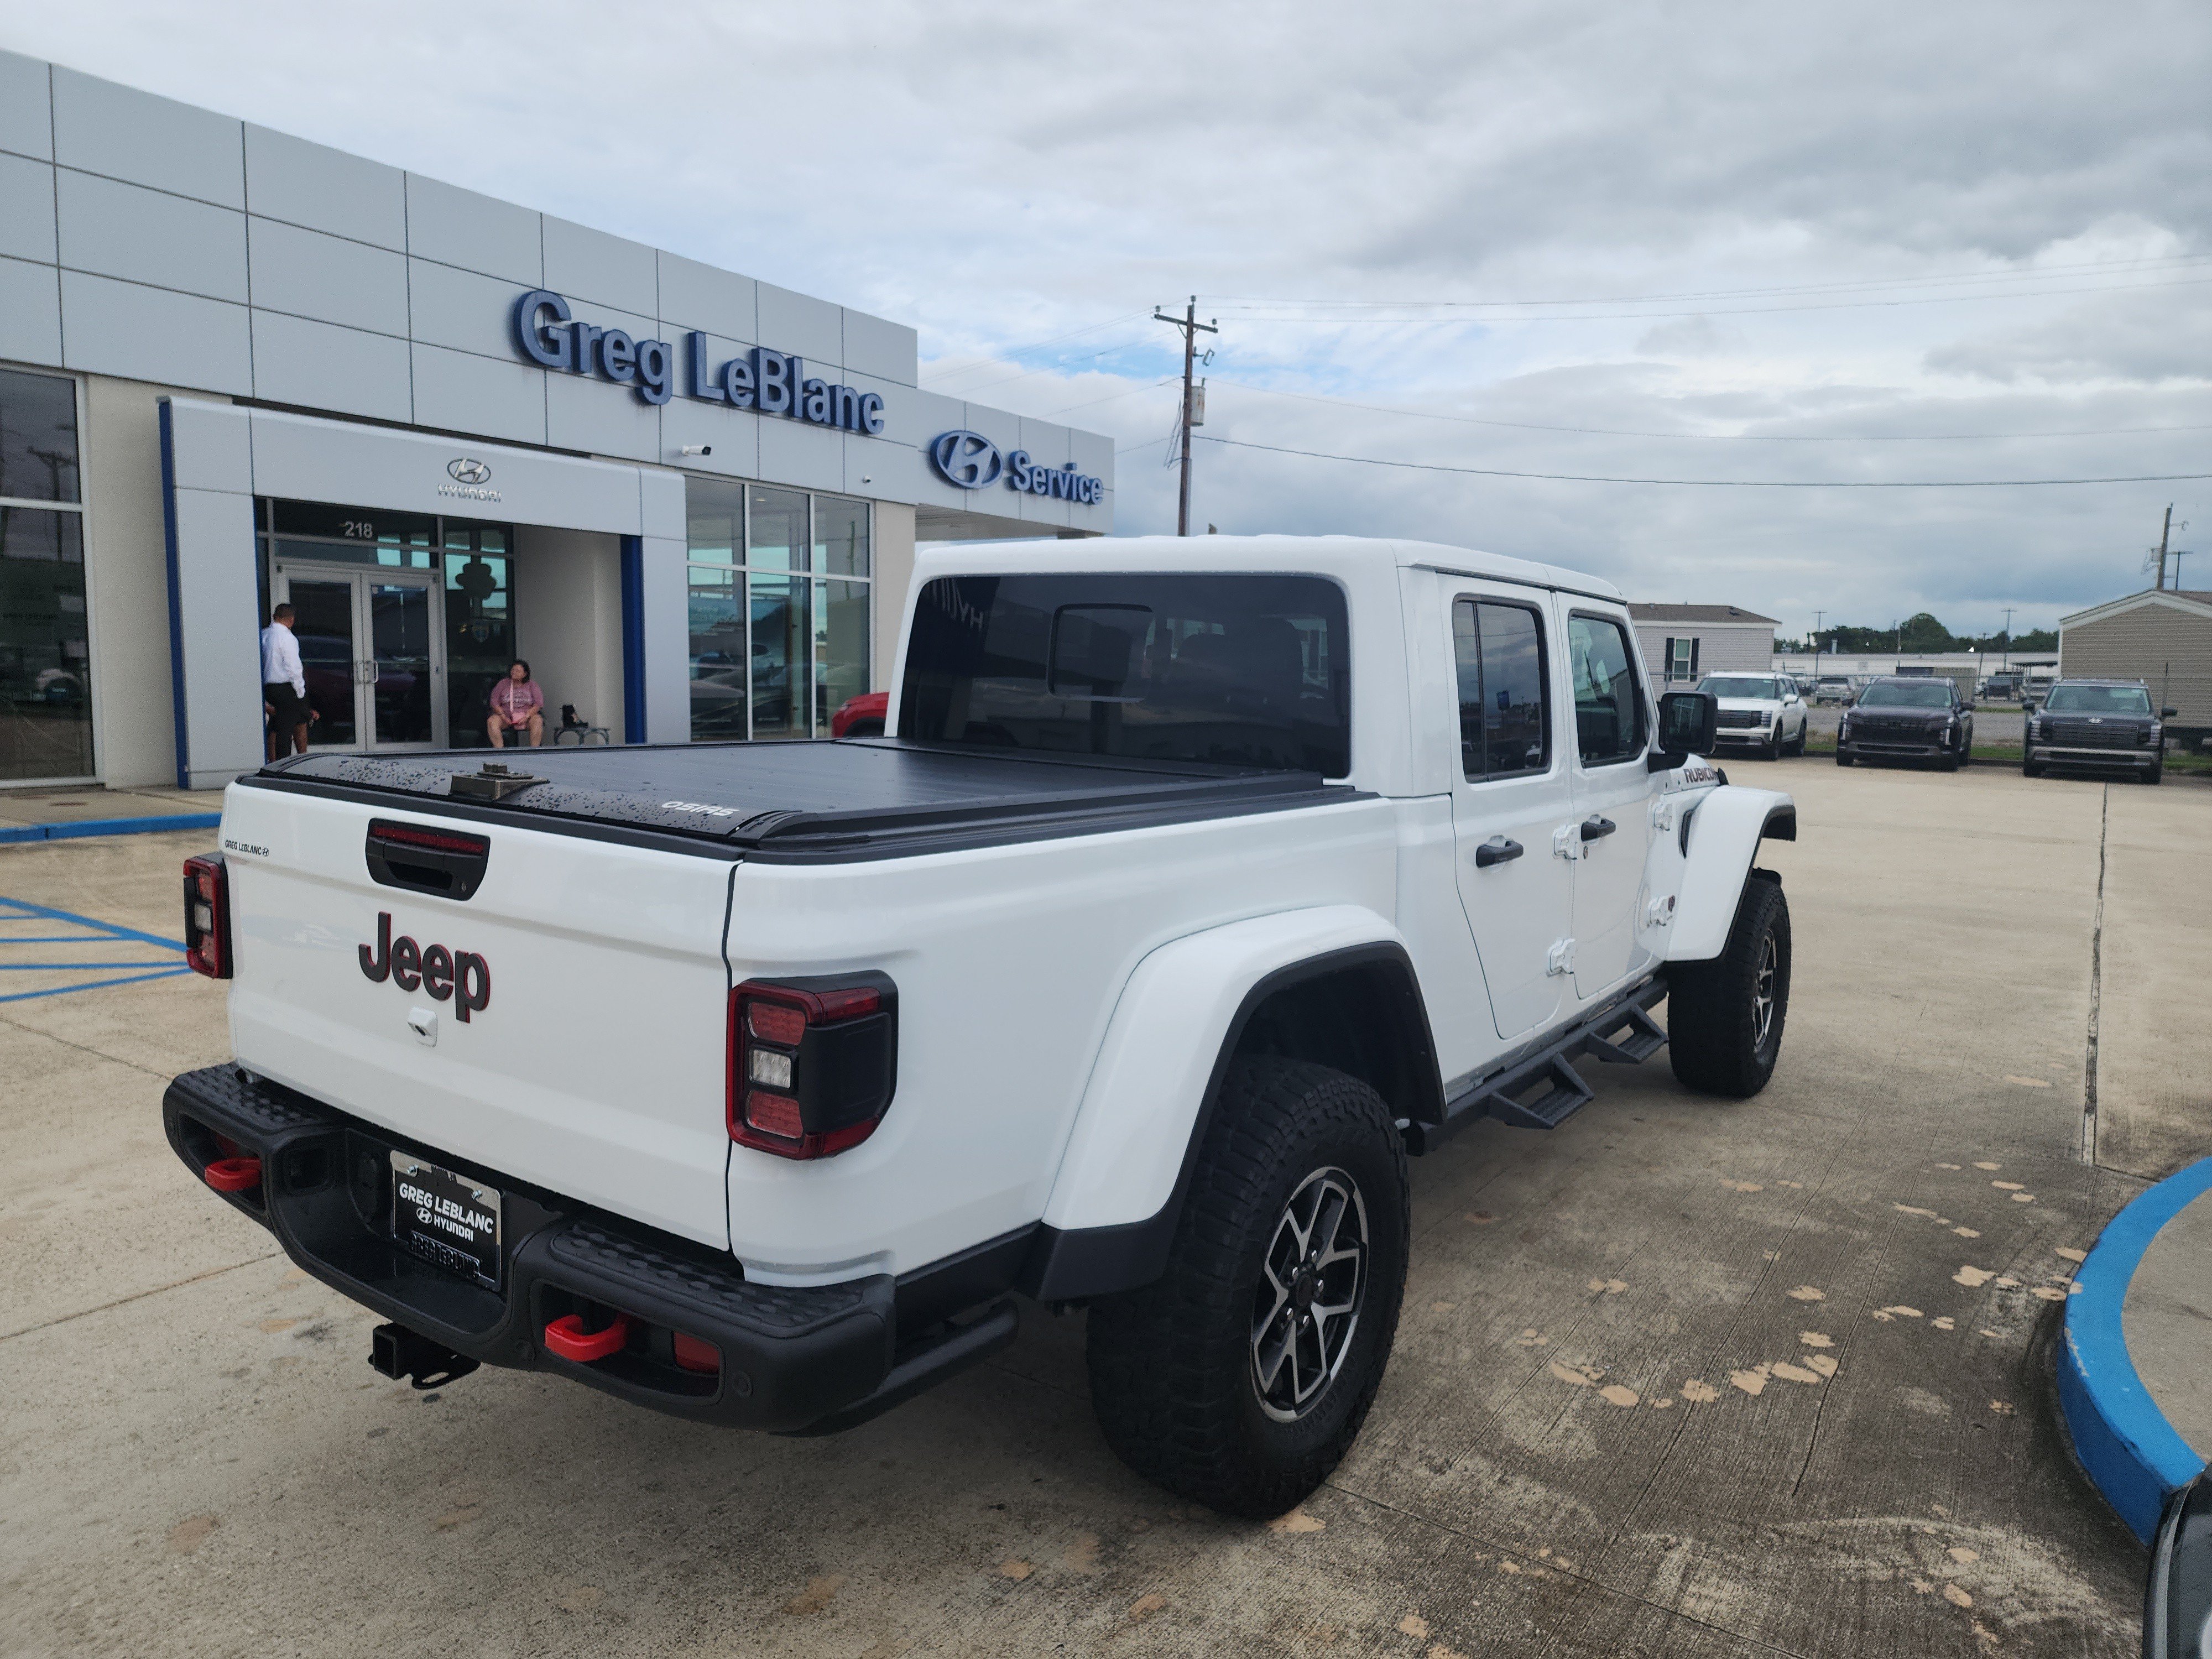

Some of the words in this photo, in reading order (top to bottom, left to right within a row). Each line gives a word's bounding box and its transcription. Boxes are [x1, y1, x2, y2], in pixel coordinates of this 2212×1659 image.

[514, 290, 673, 405] Greg
[687, 330, 884, 435] LeBlanc
[437, 483, 502, 503] HYUNDAI
[1008, 450, 1104, 505] Service
[345, 521, 373, 539] 218
[225, 839, 238, 851] GREG
[238, 842, 262, 855] LEBLANC
[358, 911, 491, 1024] Jeep
[399, 1182, 433, 1209] GREG
[435, 1195, 494, 1234] LEBLANC
[434, 1214, 474, 1243] HYUNDAI
